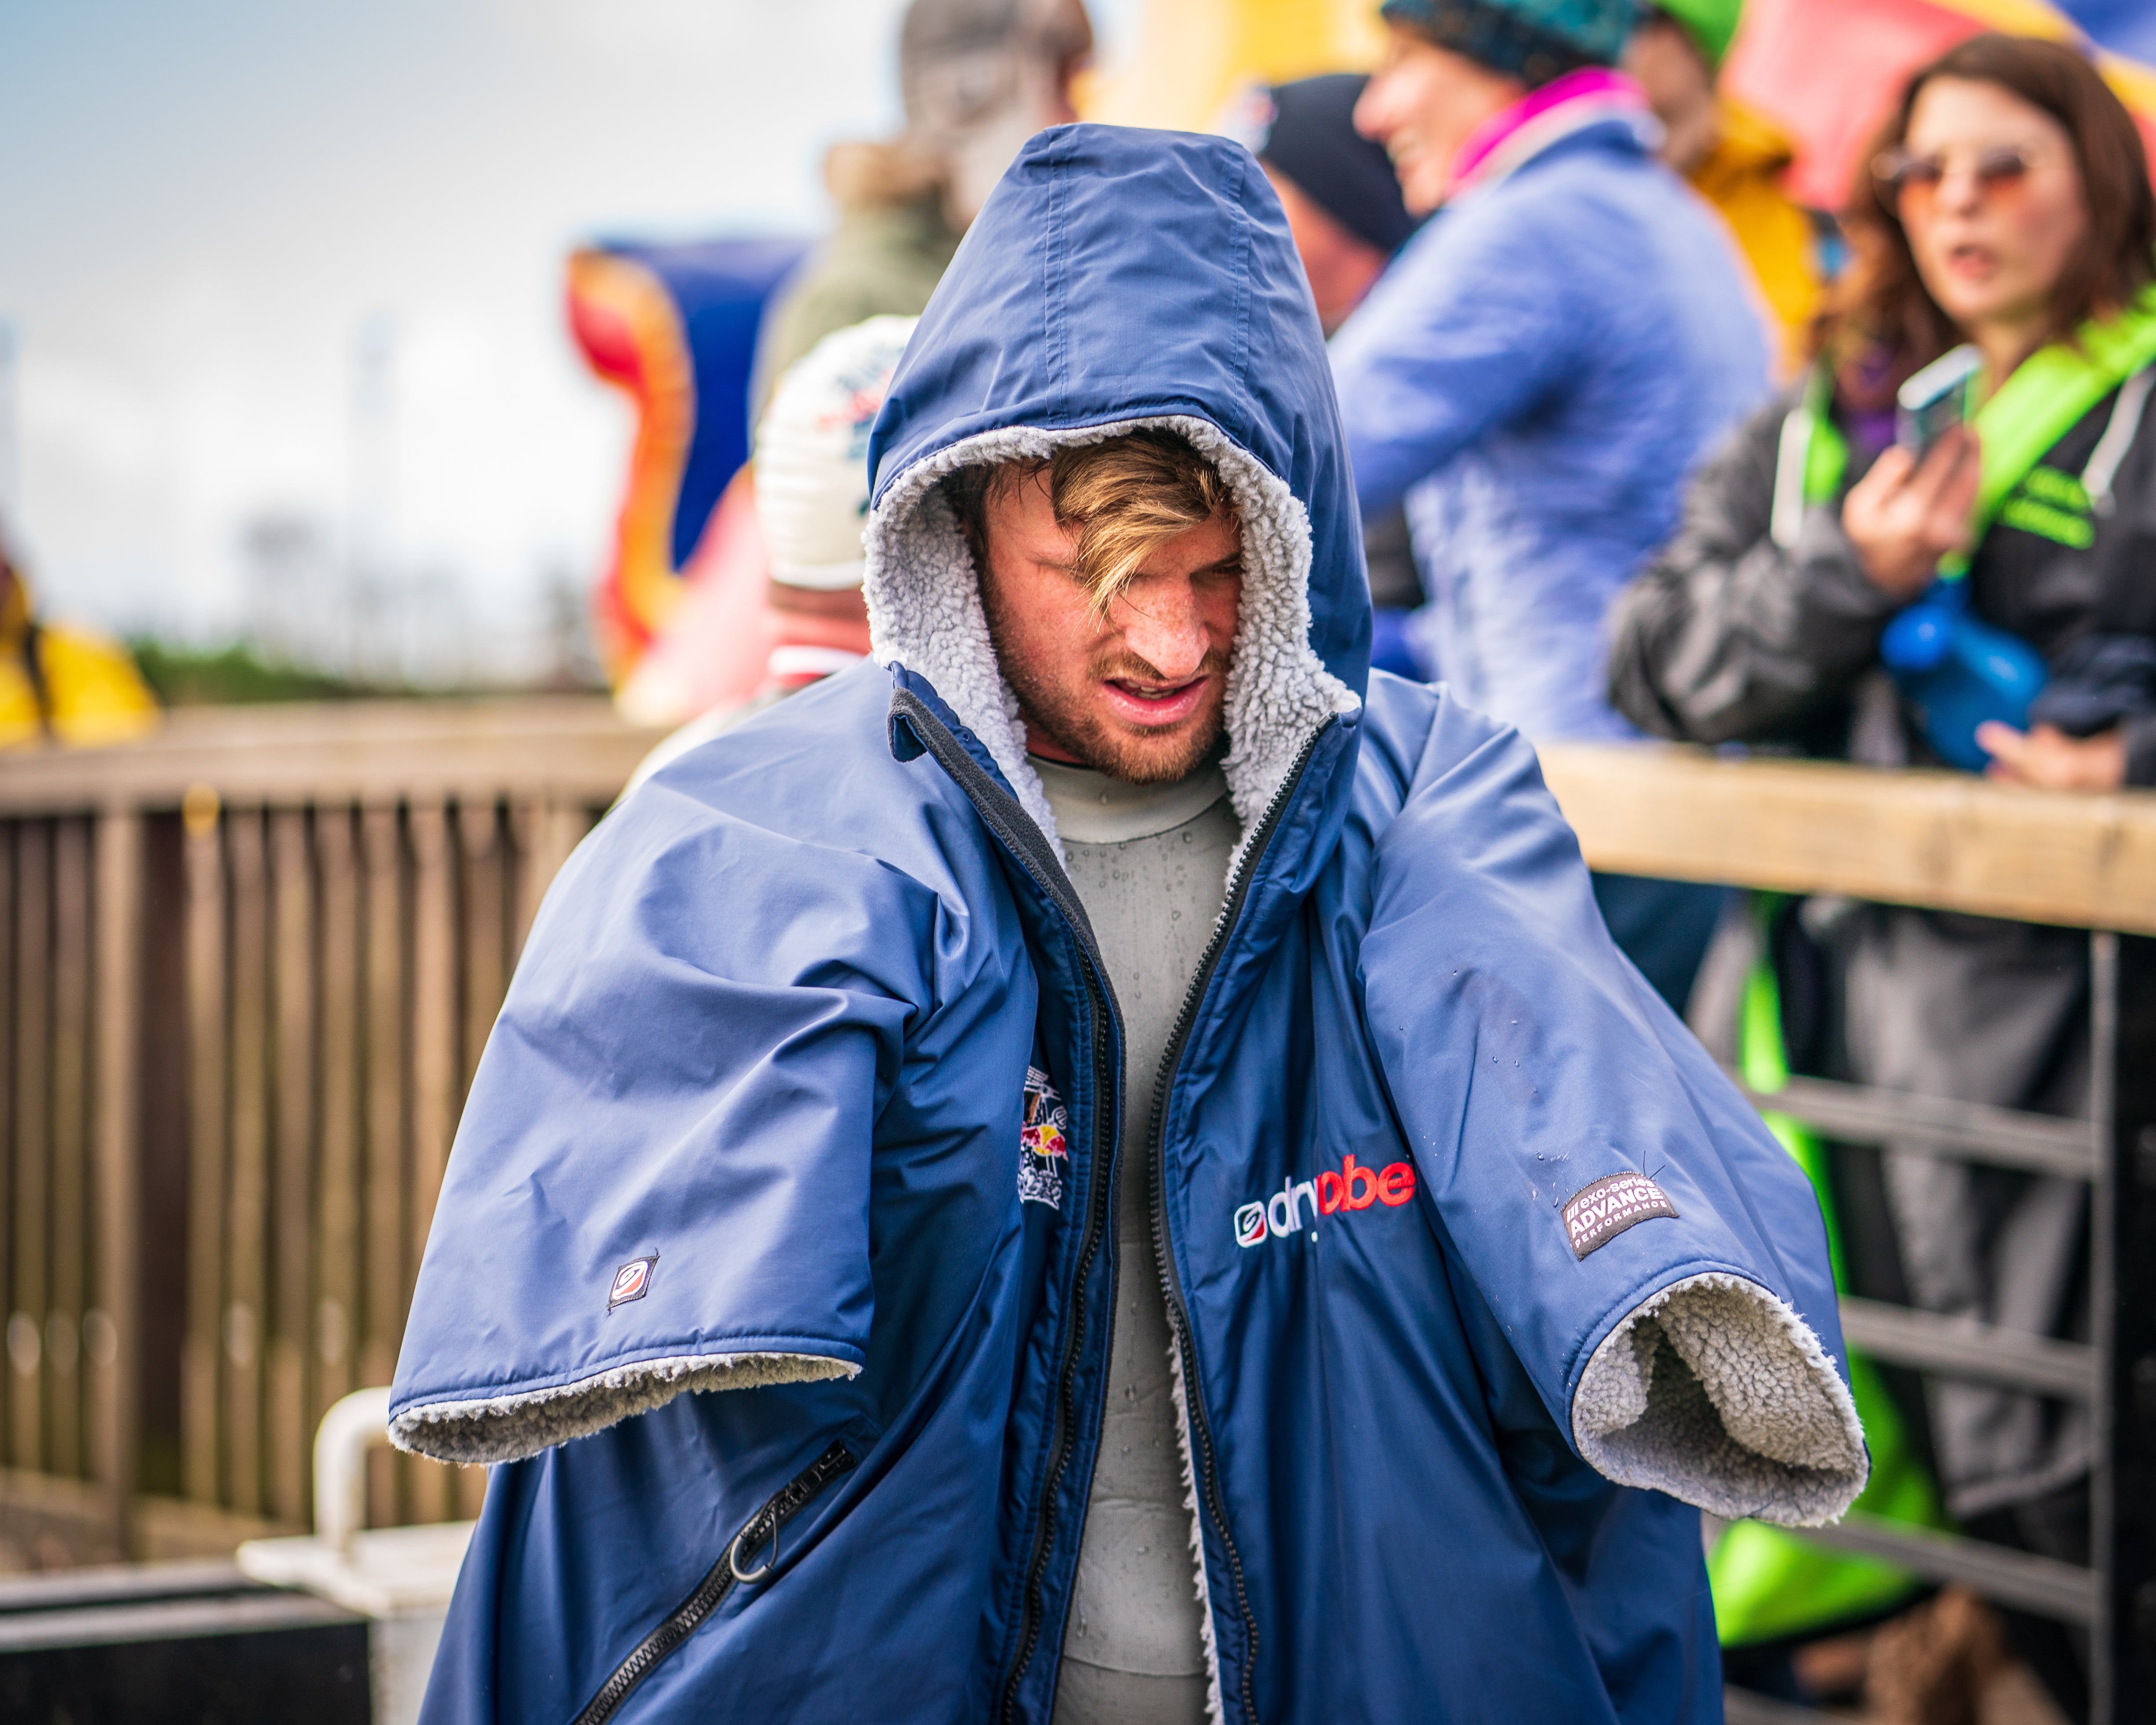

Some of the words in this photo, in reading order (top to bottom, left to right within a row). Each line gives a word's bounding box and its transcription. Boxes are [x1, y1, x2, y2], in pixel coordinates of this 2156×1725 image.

[1571, 1188, 1663, 1238] ADVANCE
[1581, 1178, 1654, 1208] exo-series
[1575, 1201, 1667, 1248] PERFORMANCE
